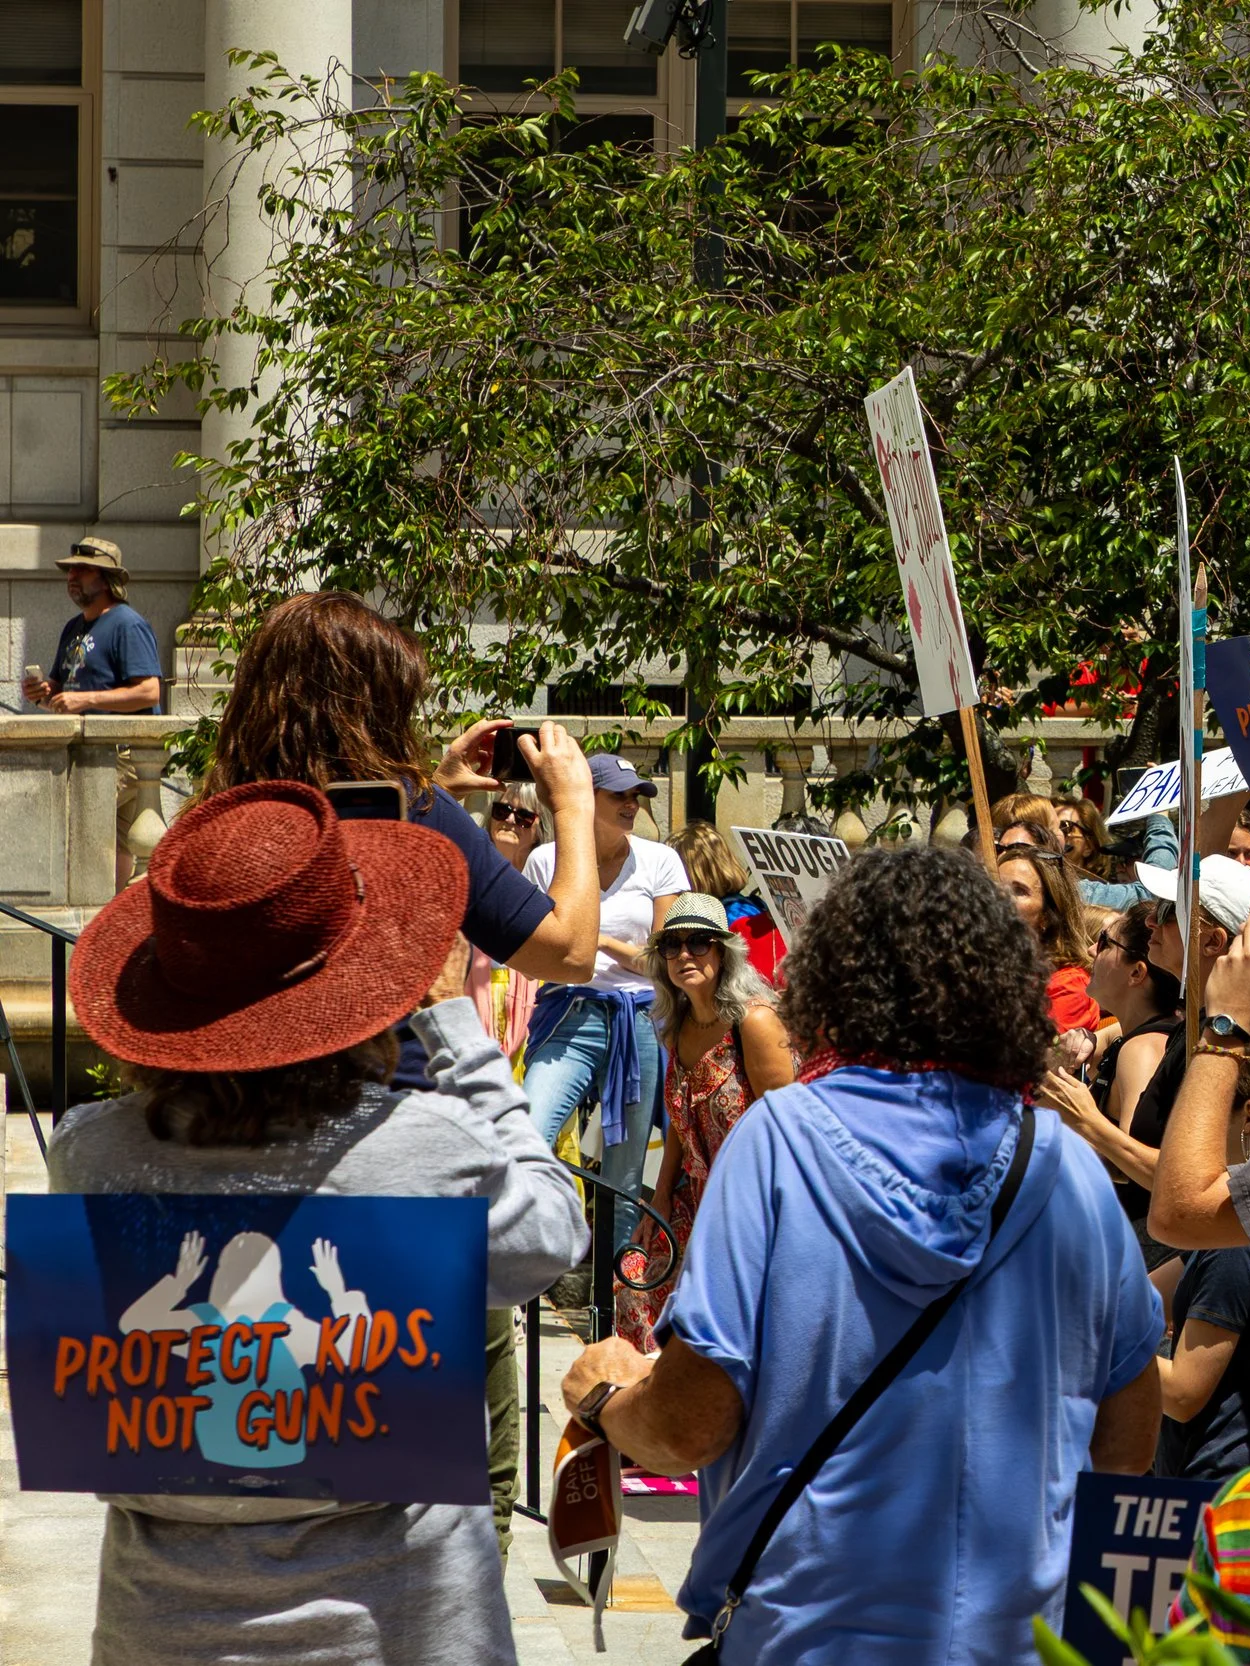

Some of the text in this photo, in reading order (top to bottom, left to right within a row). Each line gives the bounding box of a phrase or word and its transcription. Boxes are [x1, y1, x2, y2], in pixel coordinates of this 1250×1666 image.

[739, 831, 847, 879] ENOUGH
[54, 1308, 441, 1397] PROTECT KIDS,
[106, 1383, 389, 1454] NOT GUNS.
[579, 1461, 598, 1500] OFF
[1113, 1494, 1188, 1540] THE
